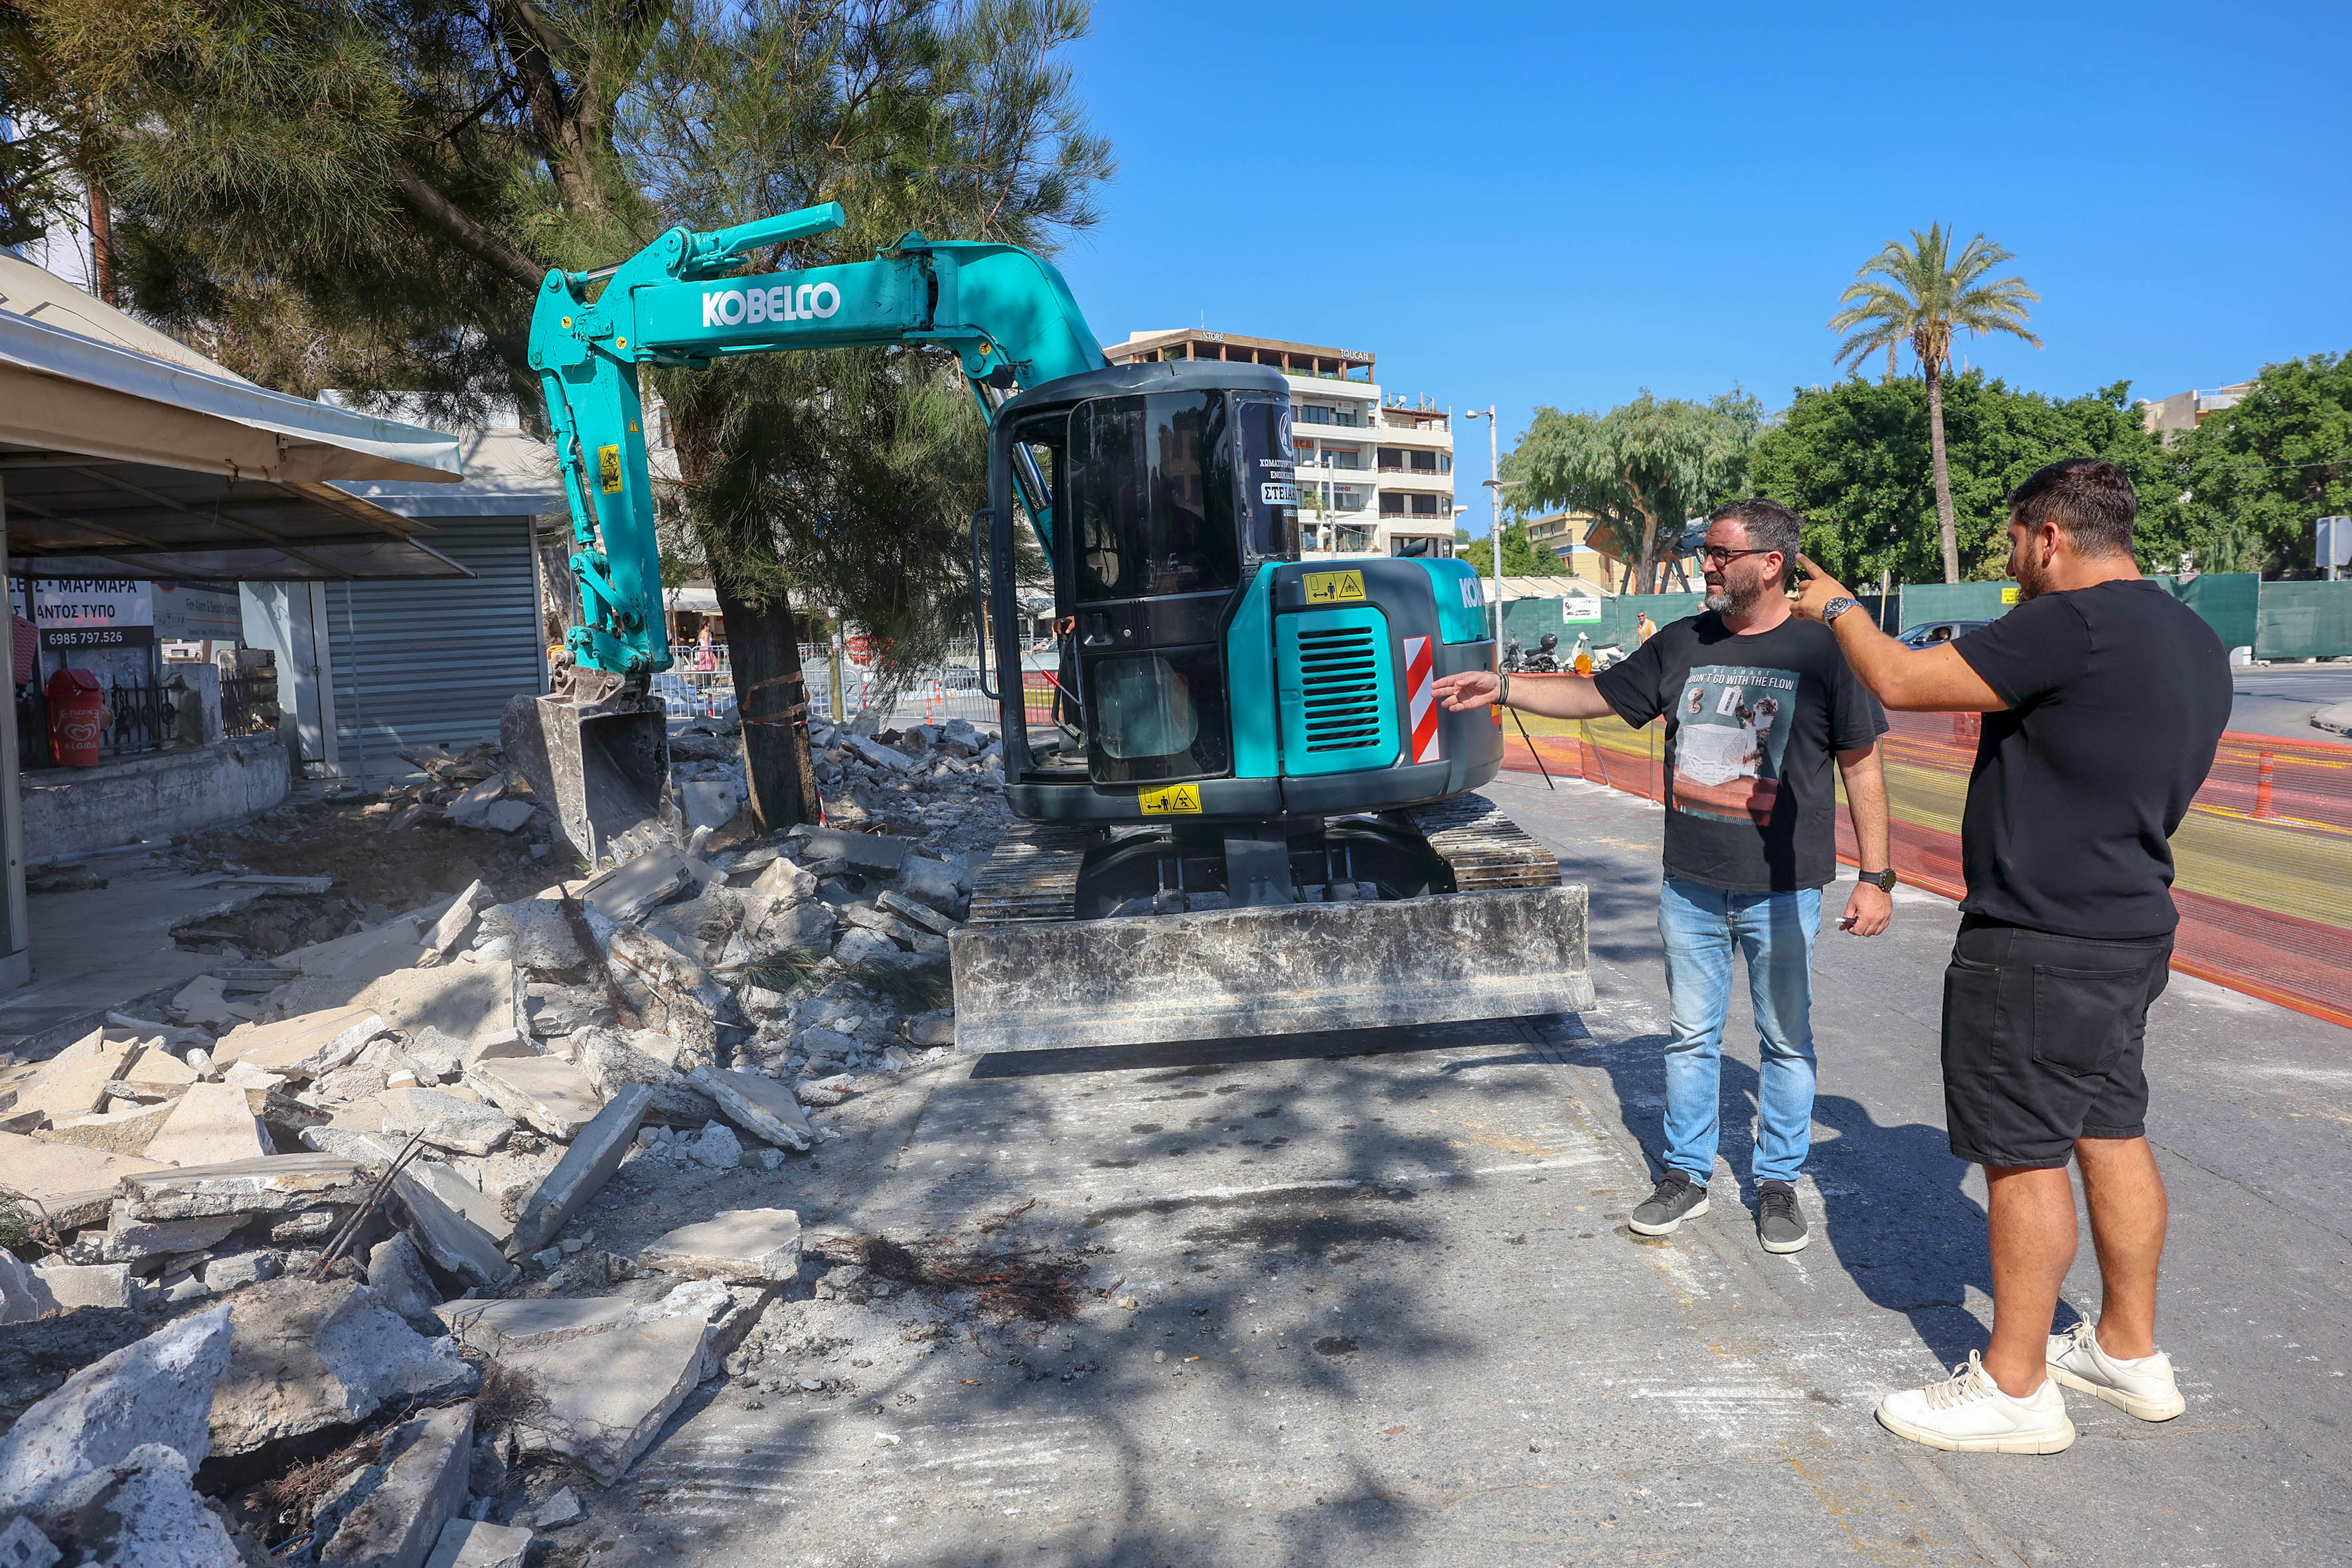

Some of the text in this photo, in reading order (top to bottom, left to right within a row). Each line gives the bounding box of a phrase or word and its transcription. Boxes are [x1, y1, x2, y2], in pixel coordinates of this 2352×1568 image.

[702, 282, 840, 327] KOBELCO
[1340, 349, 1369, 361] TOUCAN
[58, 580, 137, 593] ΜΑΡΜΑΡΑ
[37, 605, 79, 619] ΑΝΤΟΣ
[49, 631, 123, 645] 6985 797.526
[1688, 673, 1794, 690] DON'T GO WITH THE FLOW
